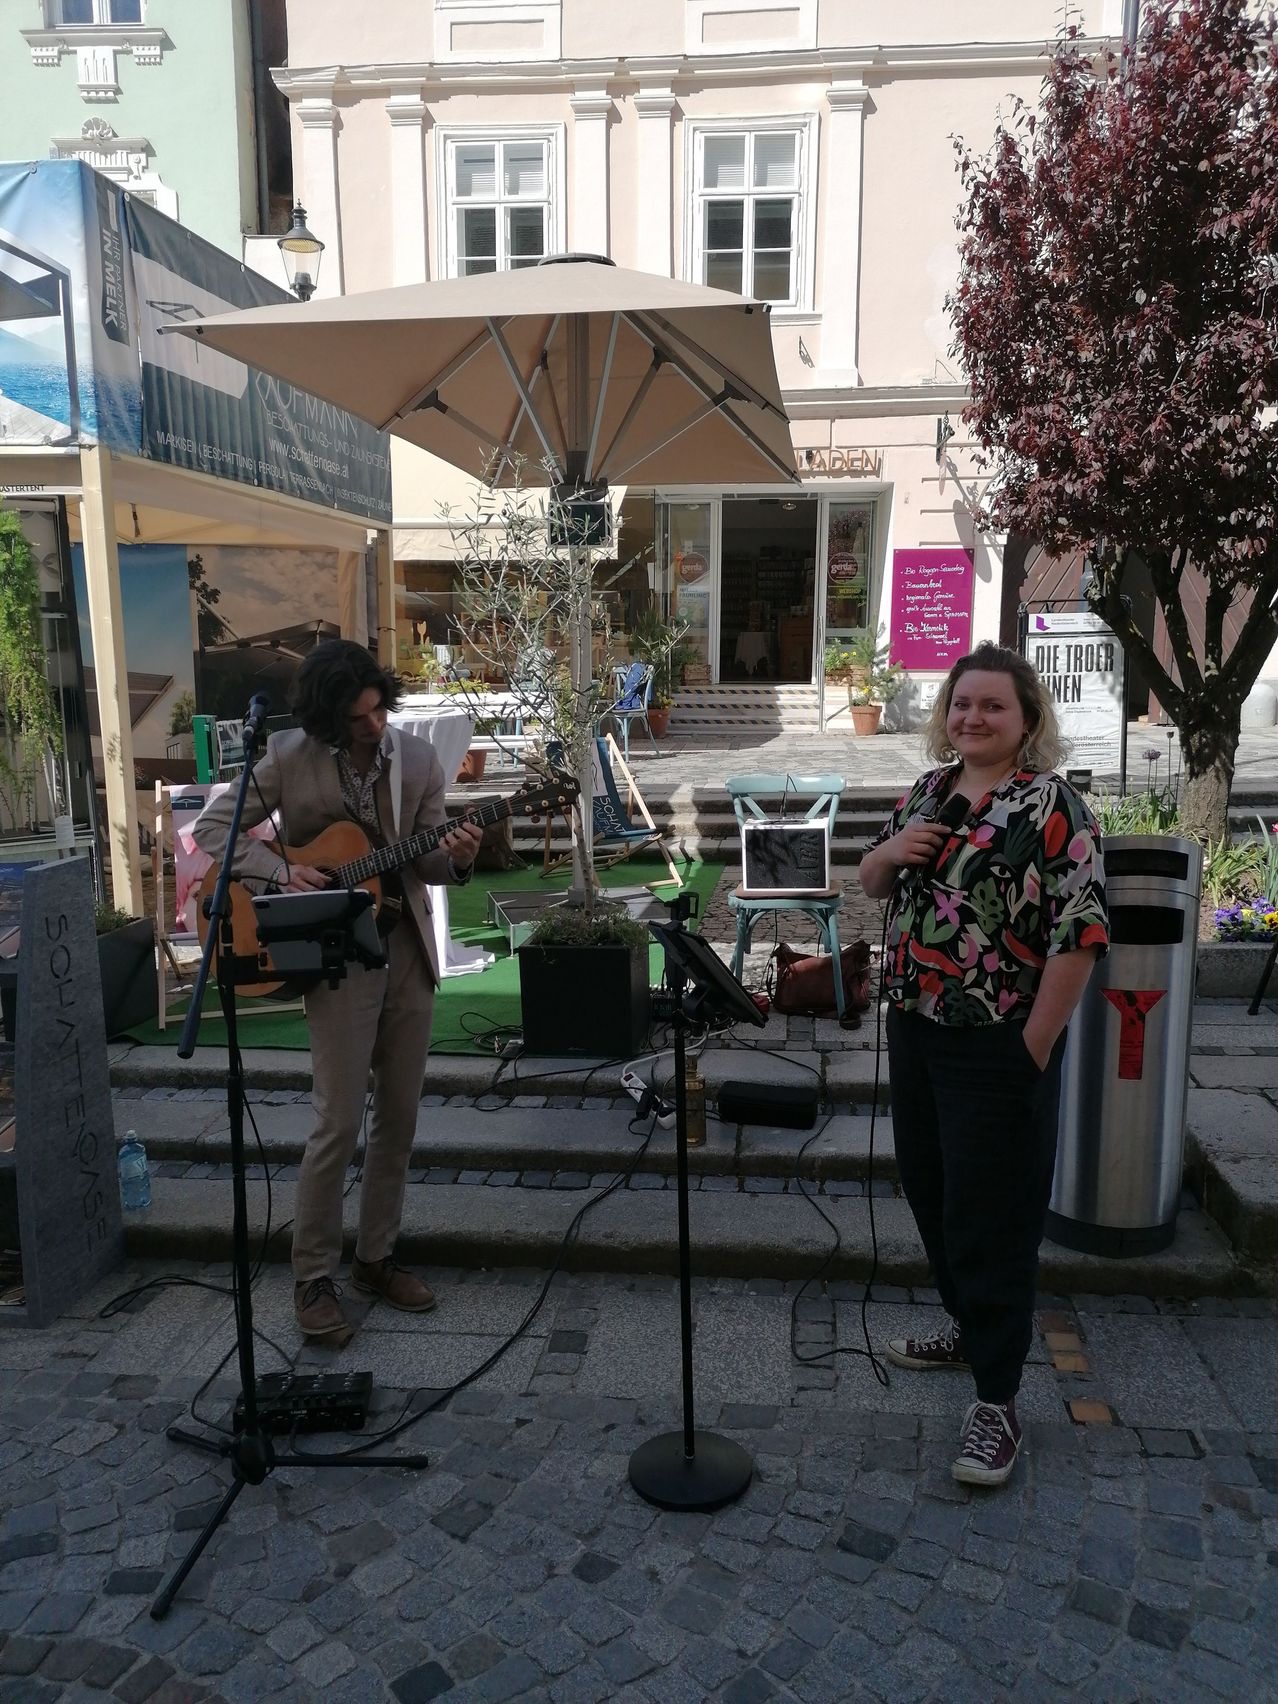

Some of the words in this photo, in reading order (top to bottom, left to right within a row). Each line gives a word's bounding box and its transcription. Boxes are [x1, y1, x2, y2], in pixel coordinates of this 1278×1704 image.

[102, 228, 113, 255] IN
[112, 236, 121, 261] IHR
[104, 258, 118, 327] MELK
[113, 264, 128, 331] PARTNER
[156, 430, 197, 453] MARKISEN
[203, 445, 254, 470] BESCHATTUNG
[0, 484, 45, 493] ASTERTENT
[1036, 645, 1059, 674] DIE
[1065, 643, 1114, 672] TROER
[1041, 674, 1082, 703] NEN
[44, 913, 107, 1252] SCHATTENOASE
